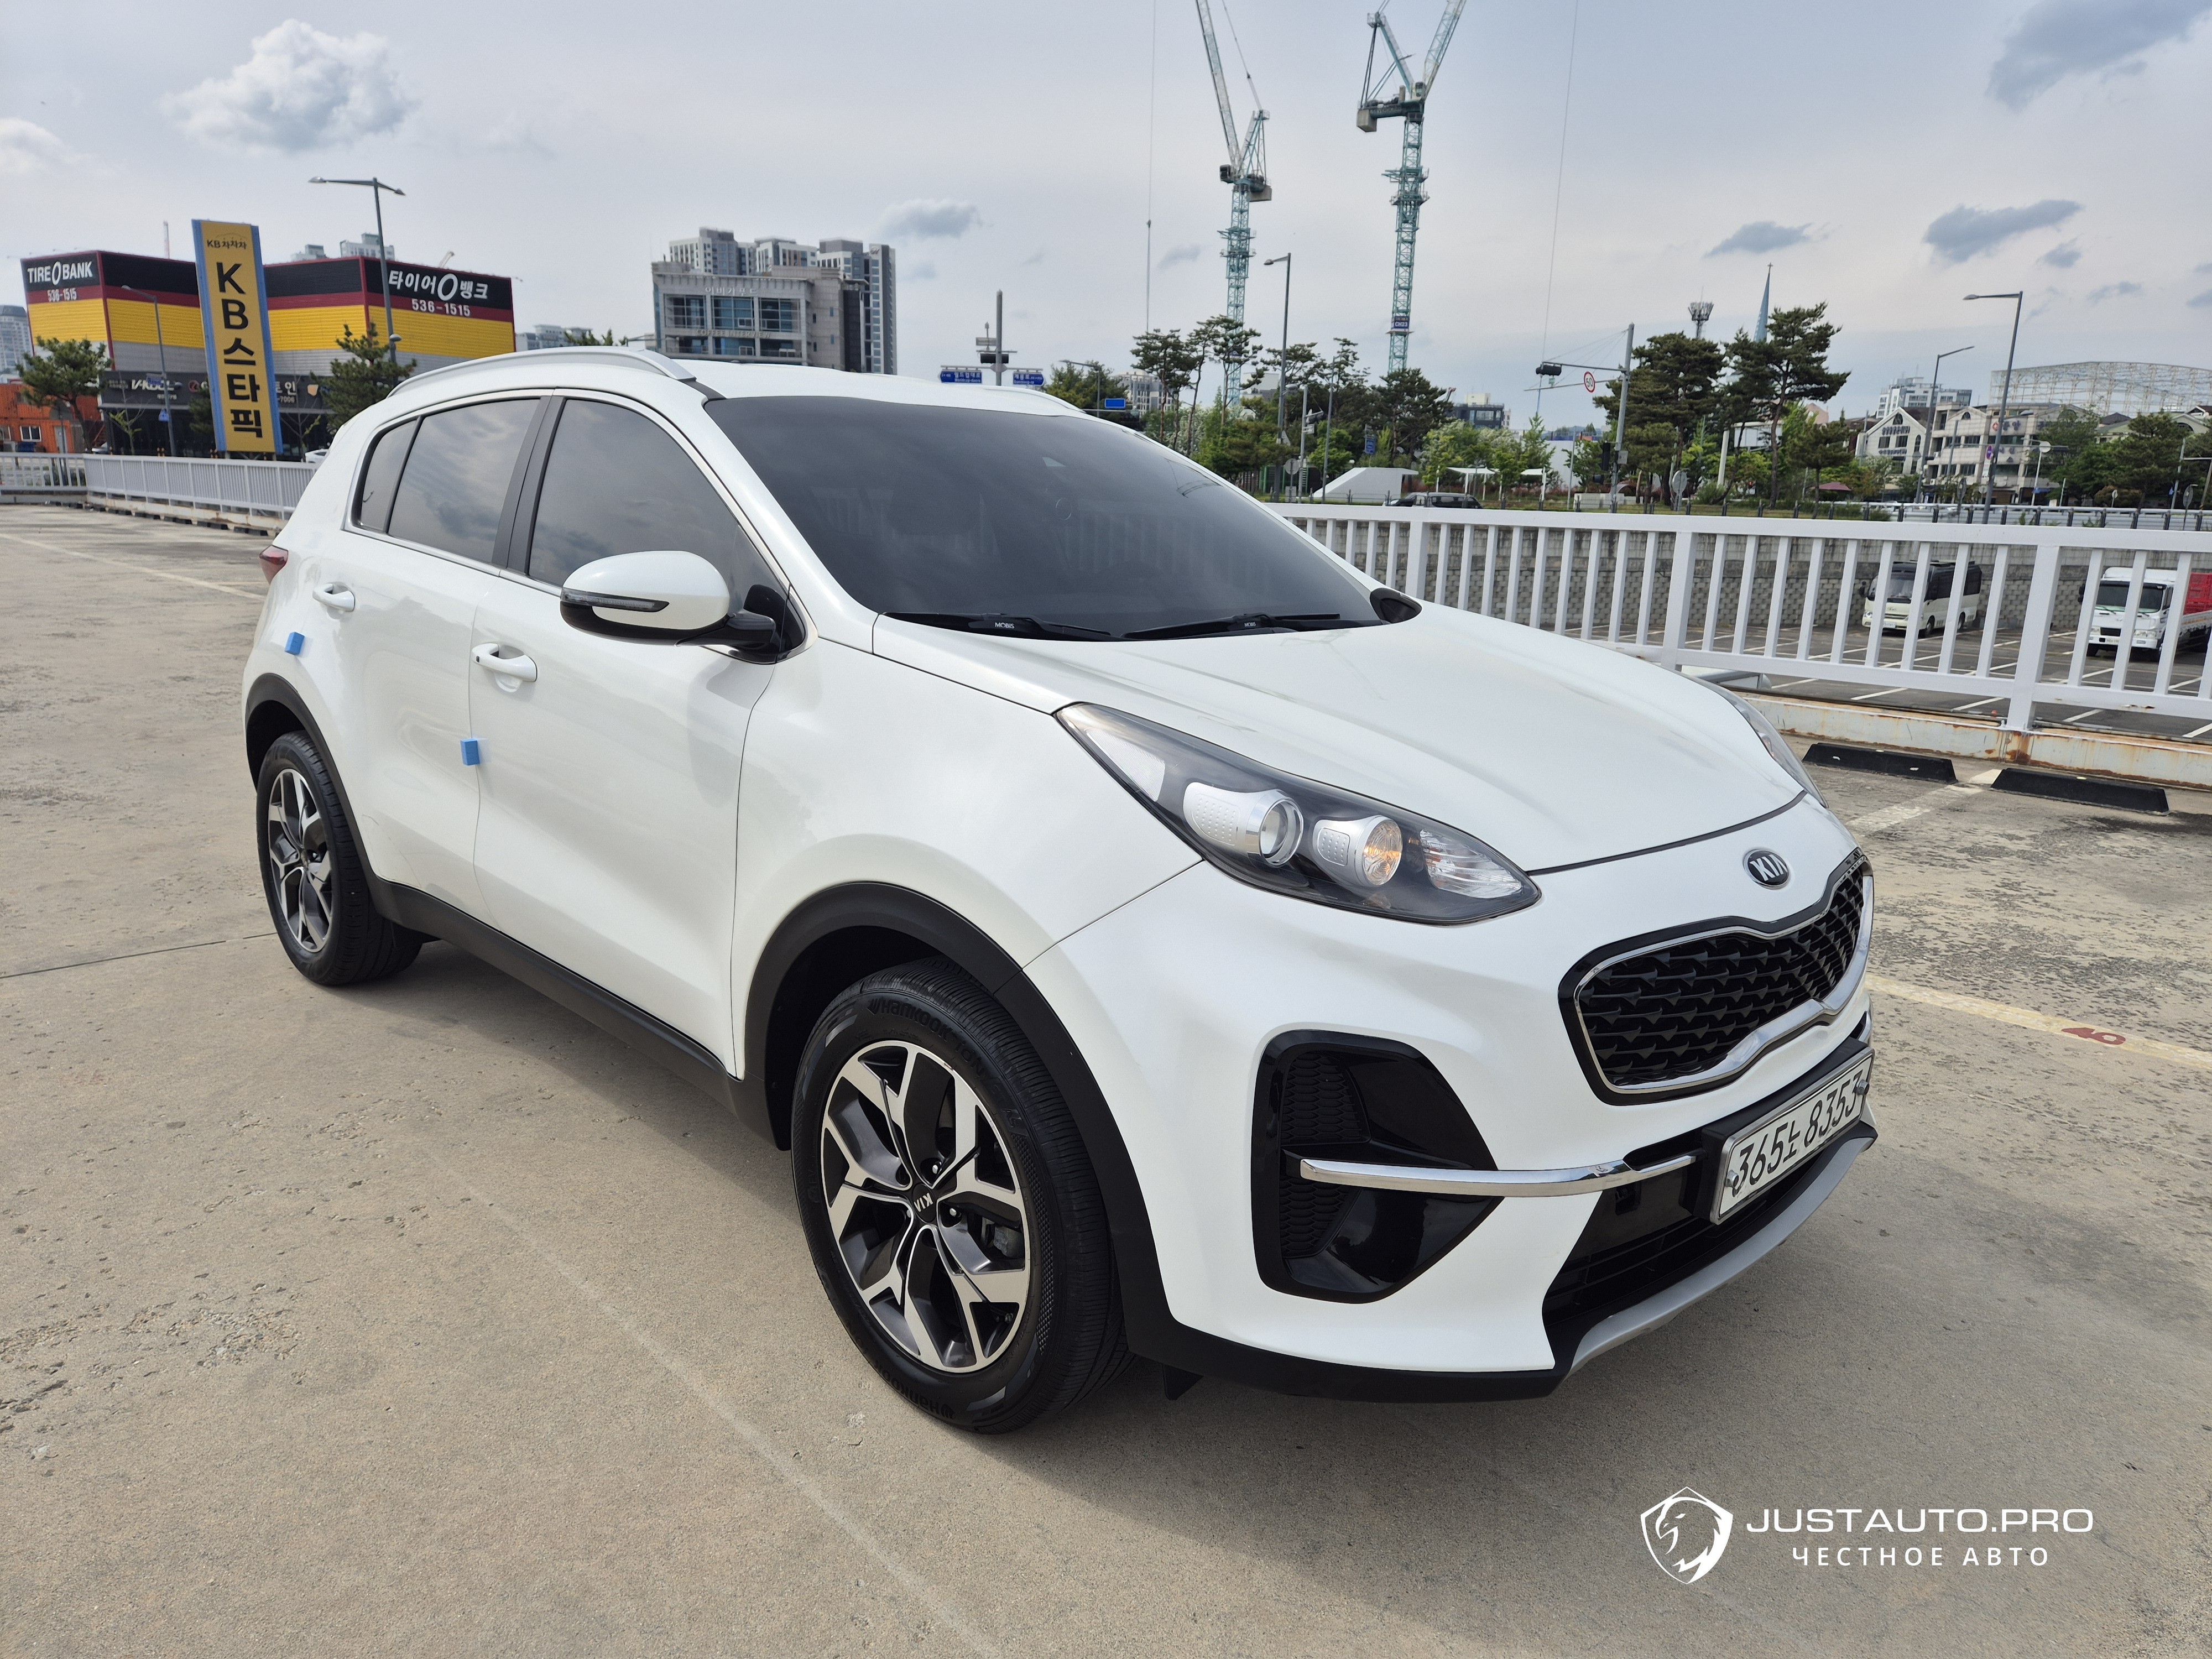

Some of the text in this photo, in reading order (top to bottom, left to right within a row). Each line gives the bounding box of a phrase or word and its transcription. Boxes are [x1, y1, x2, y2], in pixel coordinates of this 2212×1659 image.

[47, 288, 77, 302] 536-1515
[411, 298, 471, 317] 536-1515
[1586, 377, 1593, 387] 50
[1749, 854, 1788, 881] KIA
[914, 1192, 933, 1212] KIA
